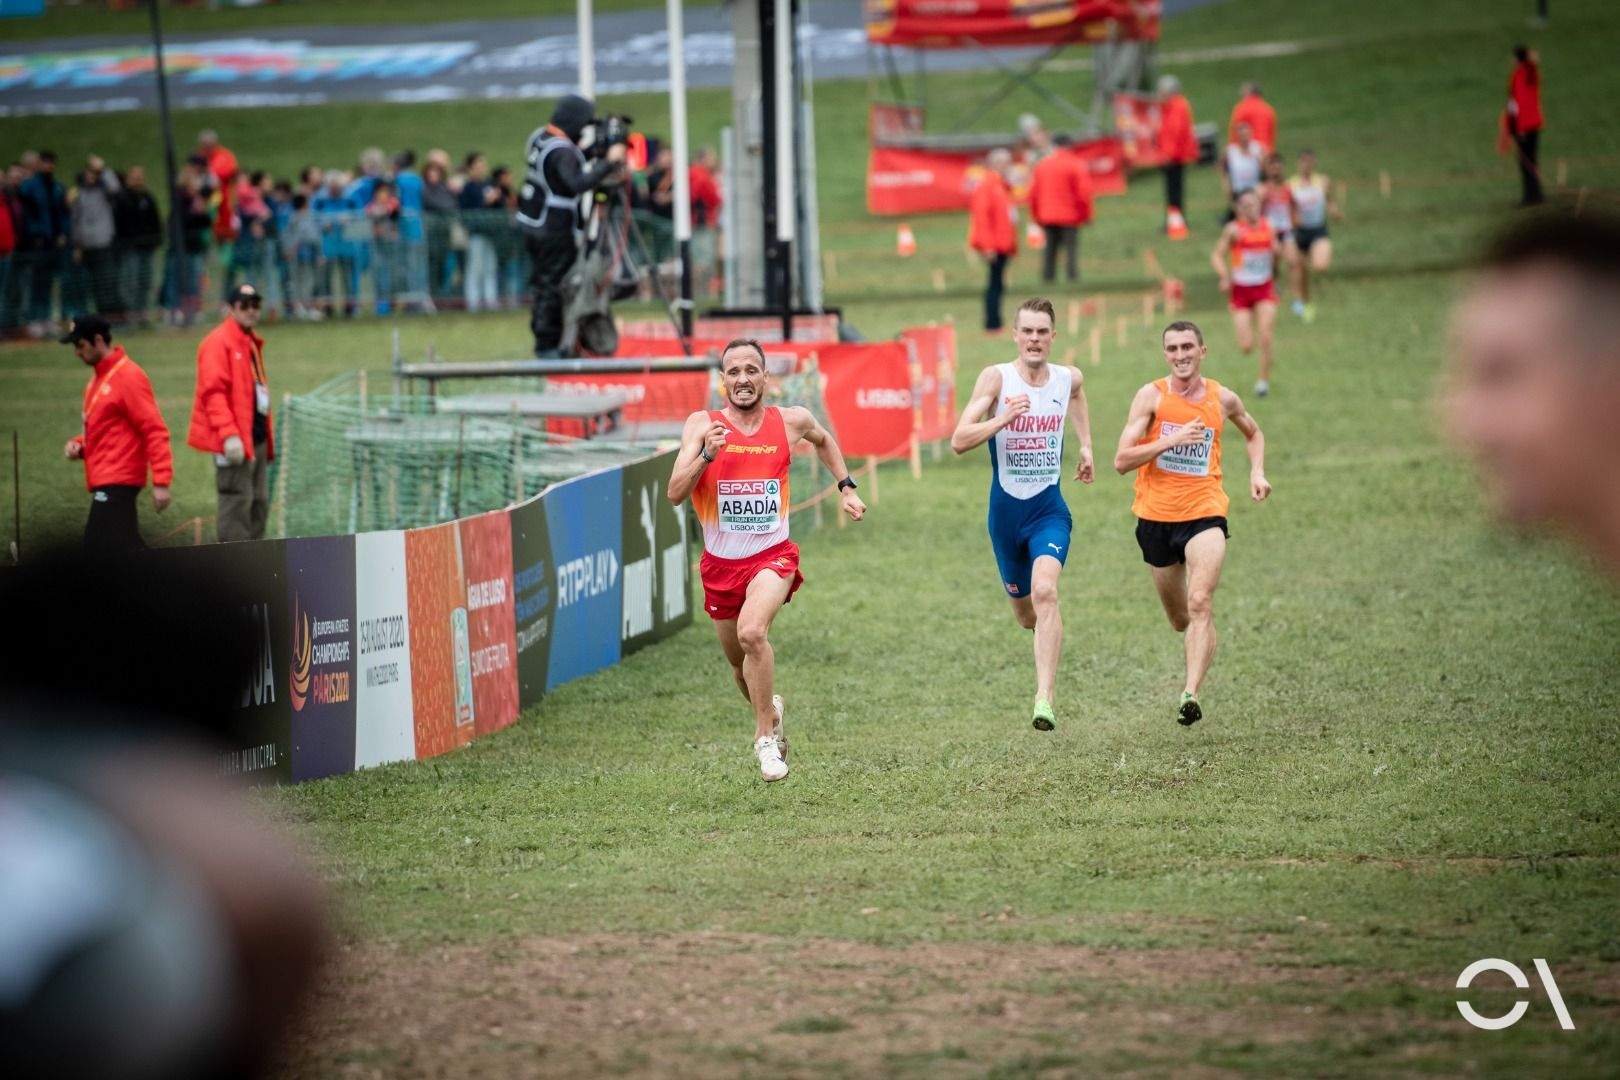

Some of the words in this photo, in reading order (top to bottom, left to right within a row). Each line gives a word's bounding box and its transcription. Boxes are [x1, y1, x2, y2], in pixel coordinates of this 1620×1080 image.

[856, 387, 913, 410] LISBO
[1005, 414, 1064, 433] NORWAY
[725, 443, 779, 455] ESPAÑA
[1006, 437, 1046, 449] SPAR
[1167, 442, 1211, 459] ADYROV
[1006, 451, 1060, 468] INGEBRIGTSEN
[719, 482, 764, 495] SPAR
[721, 496, 778, 515] ABADÍA
[756, 524, 770, 532] 2019
[312, 640, 350, 666] CHAMPIONSHIPS
